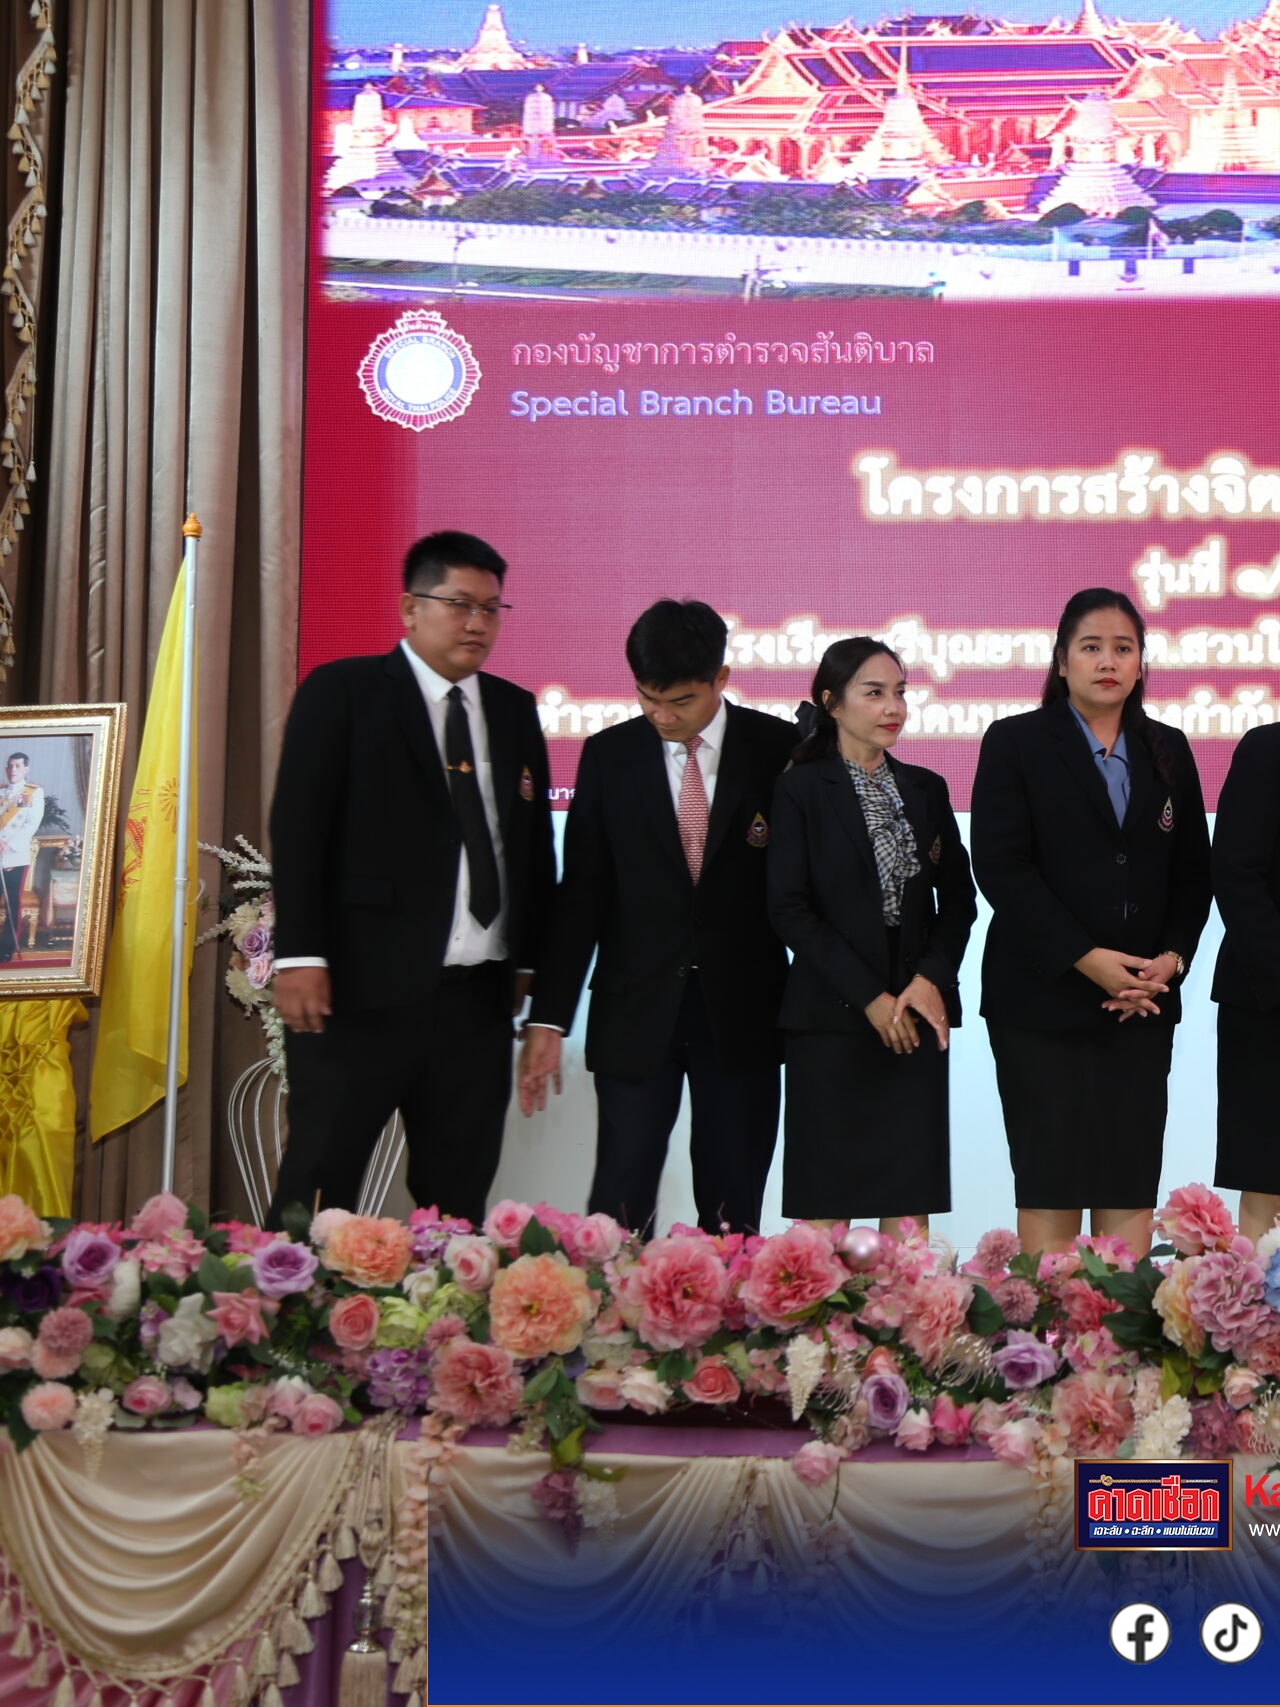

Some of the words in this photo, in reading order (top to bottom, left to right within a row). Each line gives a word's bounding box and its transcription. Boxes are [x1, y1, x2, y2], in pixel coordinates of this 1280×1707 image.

[513, 331, 934, 375] กองบัญชาการตำรวจสันติบาล
[510, 389, 629, 423] Special
[640, 388, 753, 416] Branch
[766, 389, 881, 416] Bureau
[1137, 540, 1220, 607] รุ่นที่
